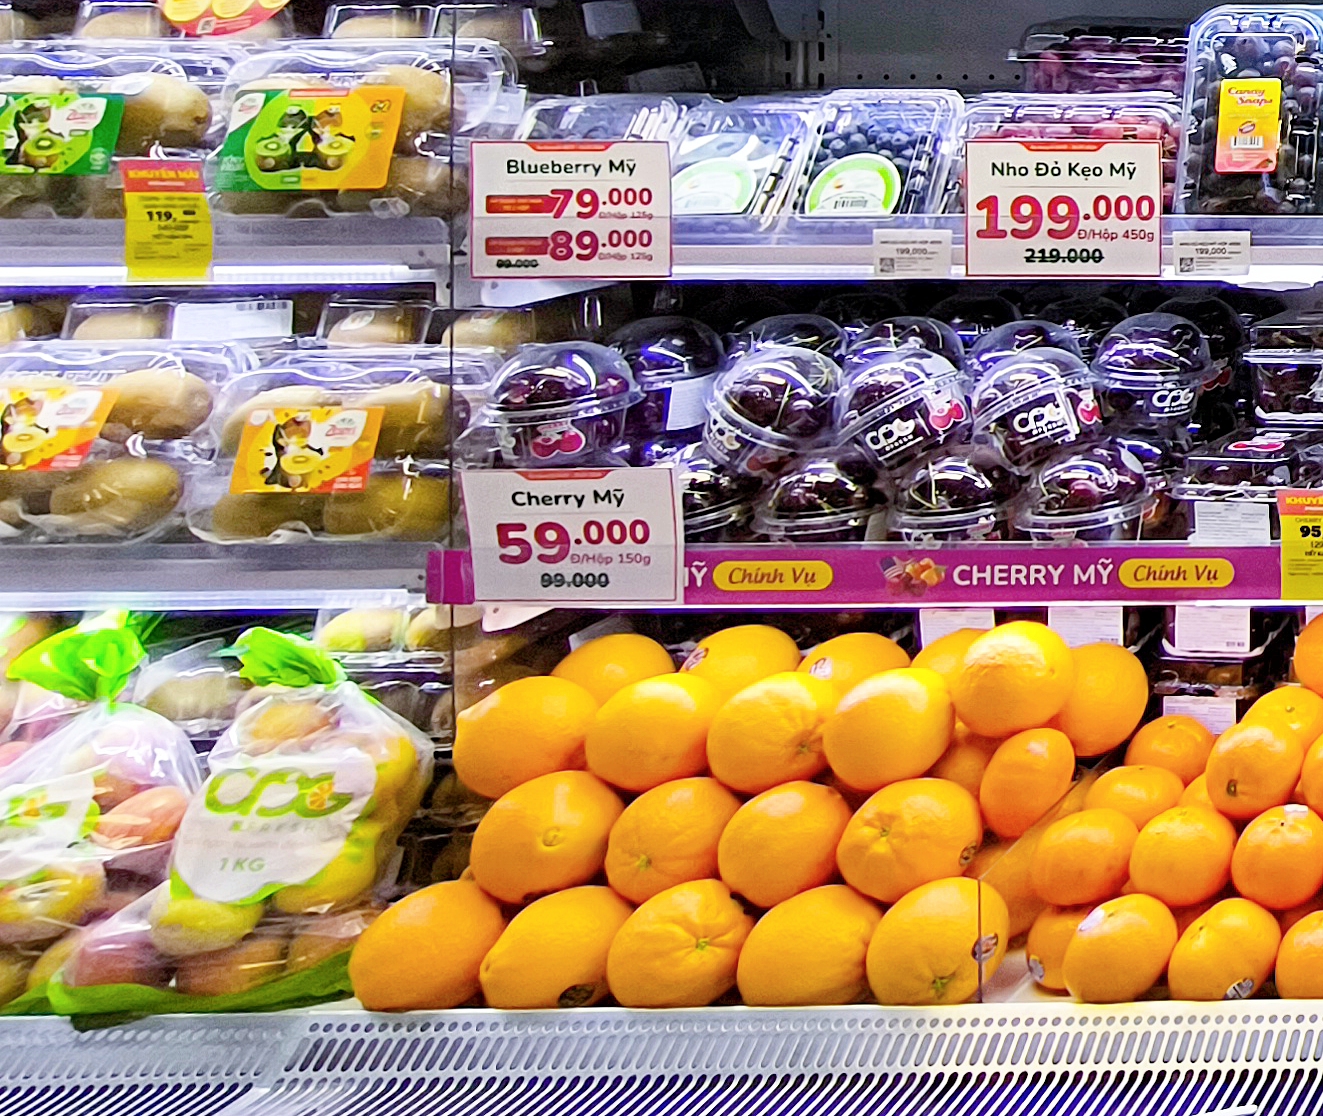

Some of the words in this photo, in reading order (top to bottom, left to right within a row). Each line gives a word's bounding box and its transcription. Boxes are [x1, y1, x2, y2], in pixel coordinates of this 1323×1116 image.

[1228, 86, 1266, 99] Candy
[506, 158, 602, 177] Blueberry
[991, 161, 1029, 178] Nho
[1035, 161, 1063, 178] Đỏ
[1068, 162, 1103, 182] Kẹo
[1108, 159, 1138, 182] Mỹ
[549, 187, 654, 220] 79.000
[975, 193, 1156, 240] 199.000
[548, 229, 654, 262] 89.000
[1077, 229, 1119, 243] Đ/Hộp
[1122, 229, 1155, 243] 450g
[1023, 248, 1104, 265] 219.000
[511, 490, 585, 509] Cherry
[592, 488, 626, 508] Mỹ
[496, 518, 650, 565] 59.000
[618, 553, 652, 566] 150g
[728, 566, 786, 586] Chính
[790, 566, 817, 588] Vụ
[952, 562, 1065, 585] CHERRY
[1071, 558, 1115, 586] MỸ
[1132, 563, 1188, 583] Chính
[1192, 563, 1219, 585] Vụ
[232, 857, 267, 873] KG
